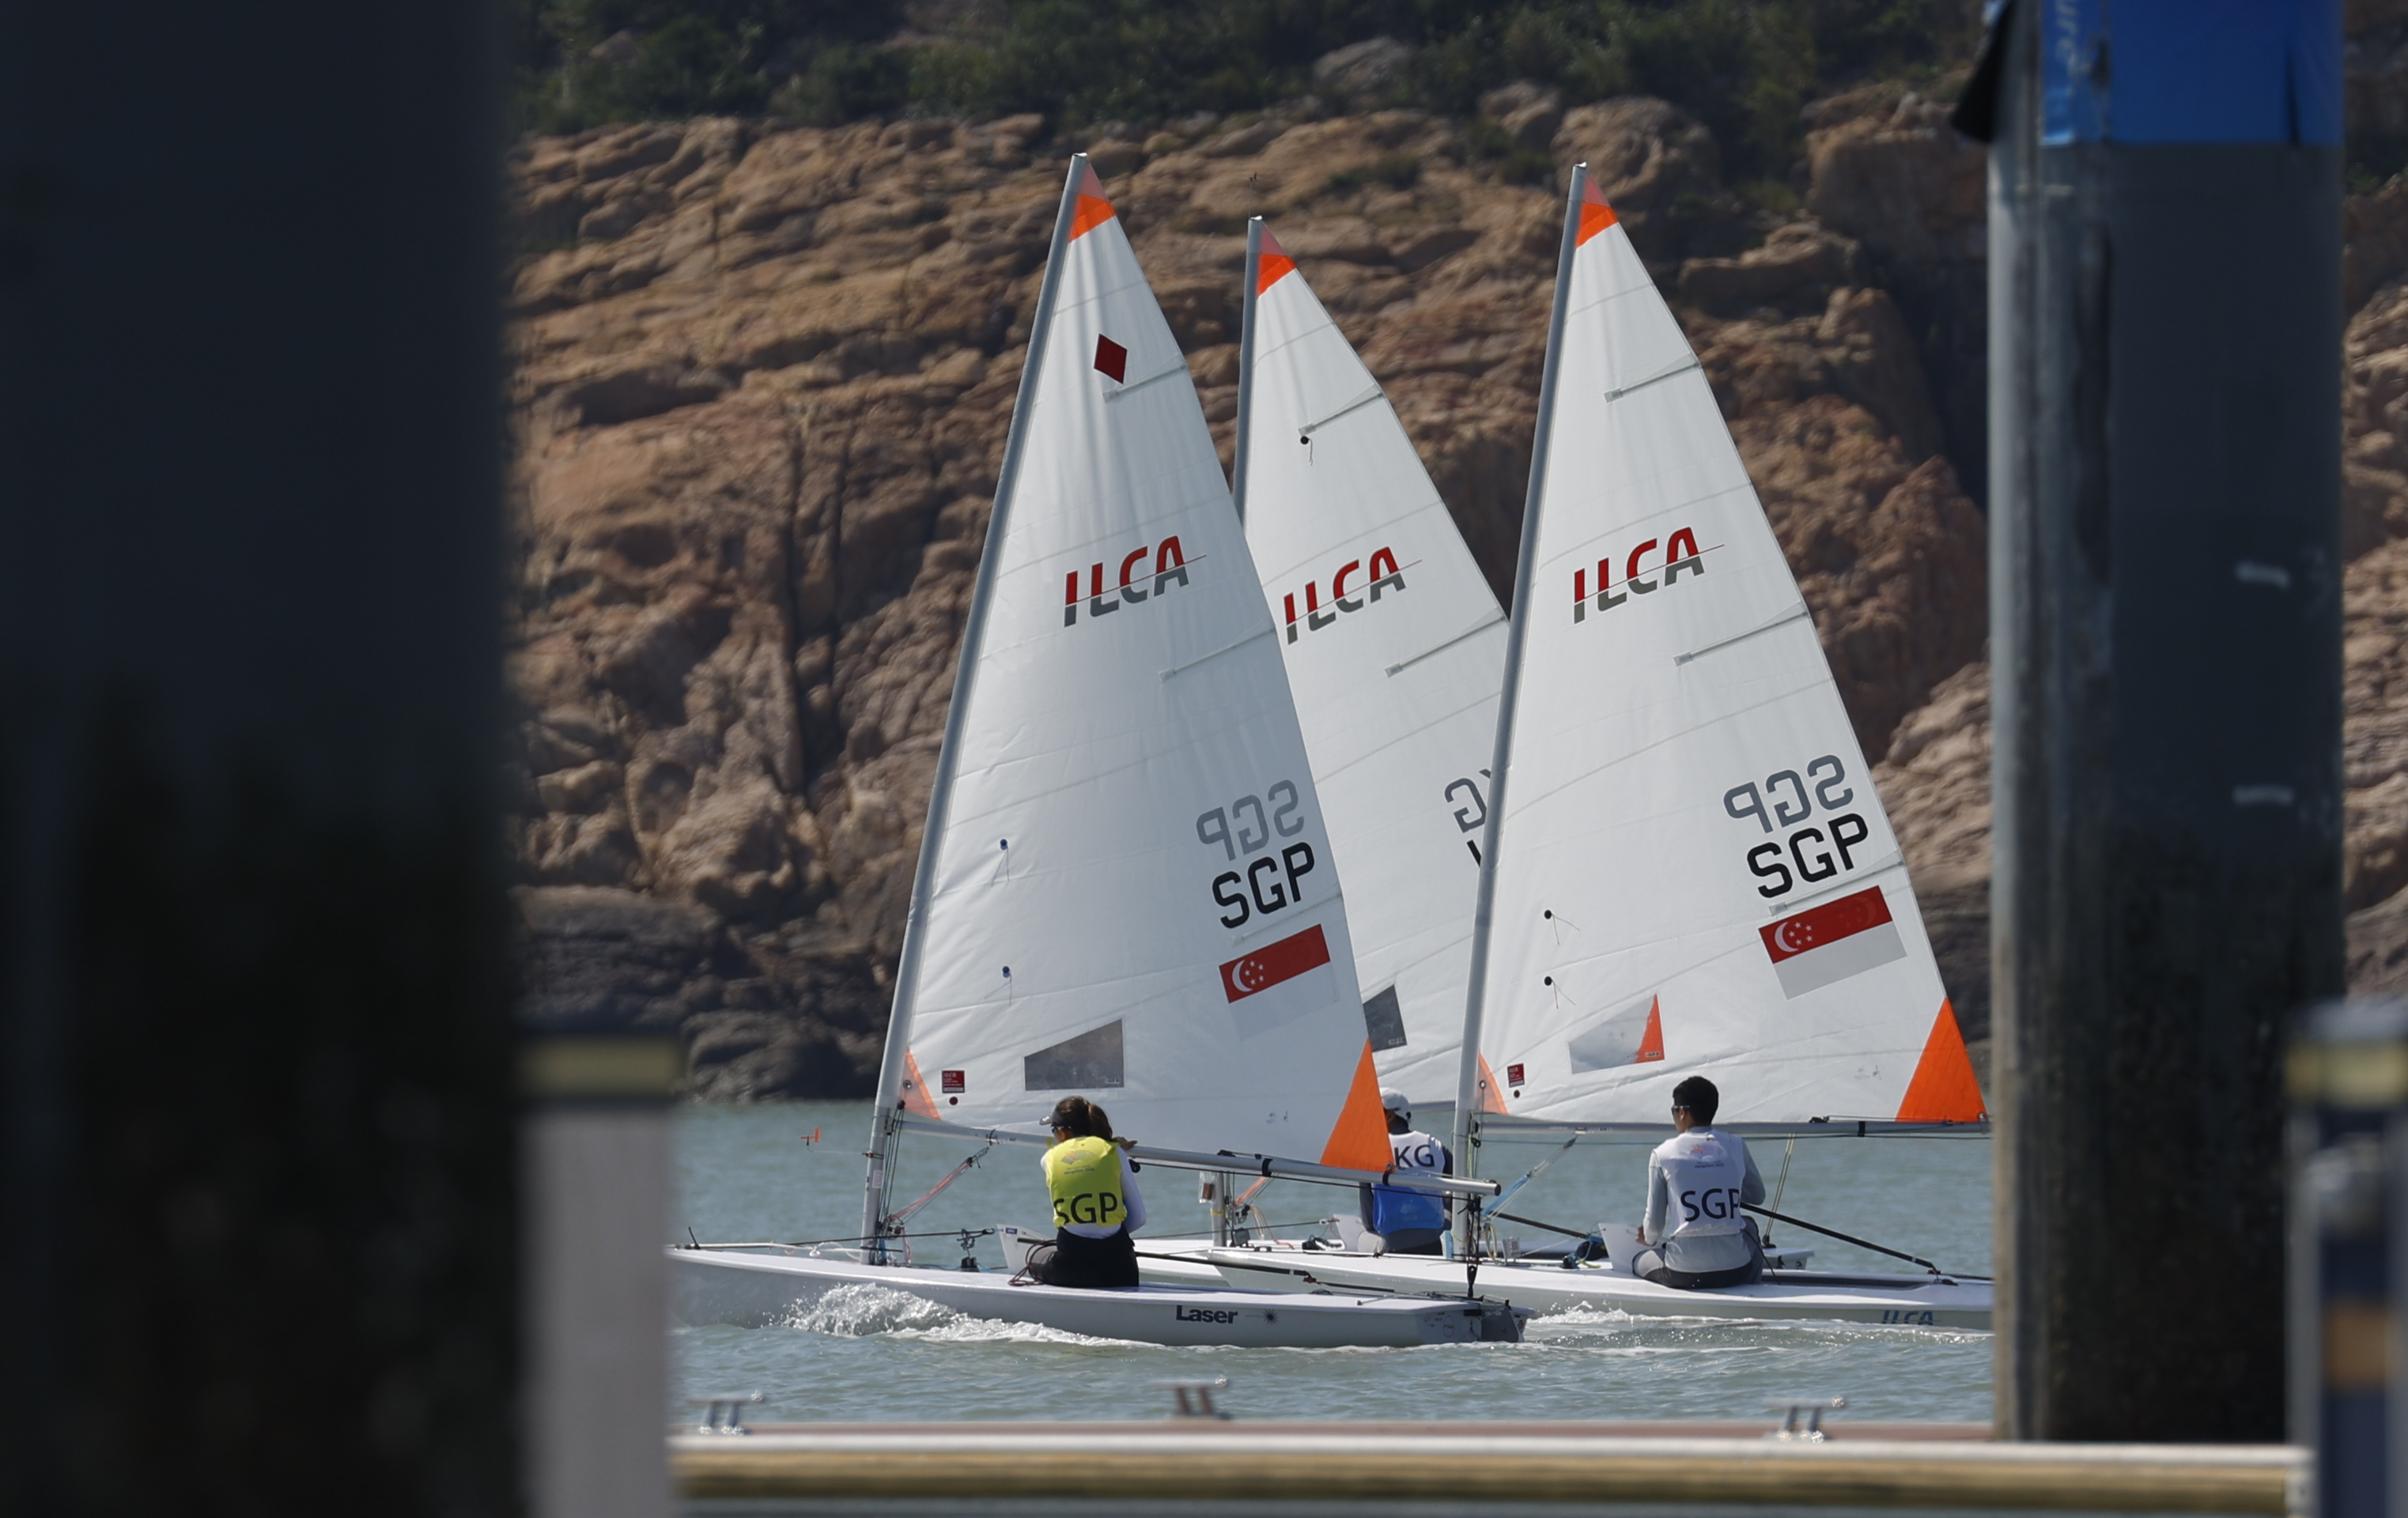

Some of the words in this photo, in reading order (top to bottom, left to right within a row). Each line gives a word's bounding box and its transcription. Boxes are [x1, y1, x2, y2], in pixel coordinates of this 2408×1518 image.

[1064, 535, 1189, 627] ILCA
[1283, 546, 1406, 645] ILCA
[1574, 527, 1705, 624] ILCA
[1212, 841, 1315, 929] SGP
[1746, 813, 1869, 898] SGP
[1394, 1144, 1435, 1167] KG
[1053, 1192, 1117, 1224] SGP
[1680, 1188, 1739, 1222] SGP
[1176, 1305, 1238, 1324] Laser
[1882, 1309, 1934, 1325] ILCA
